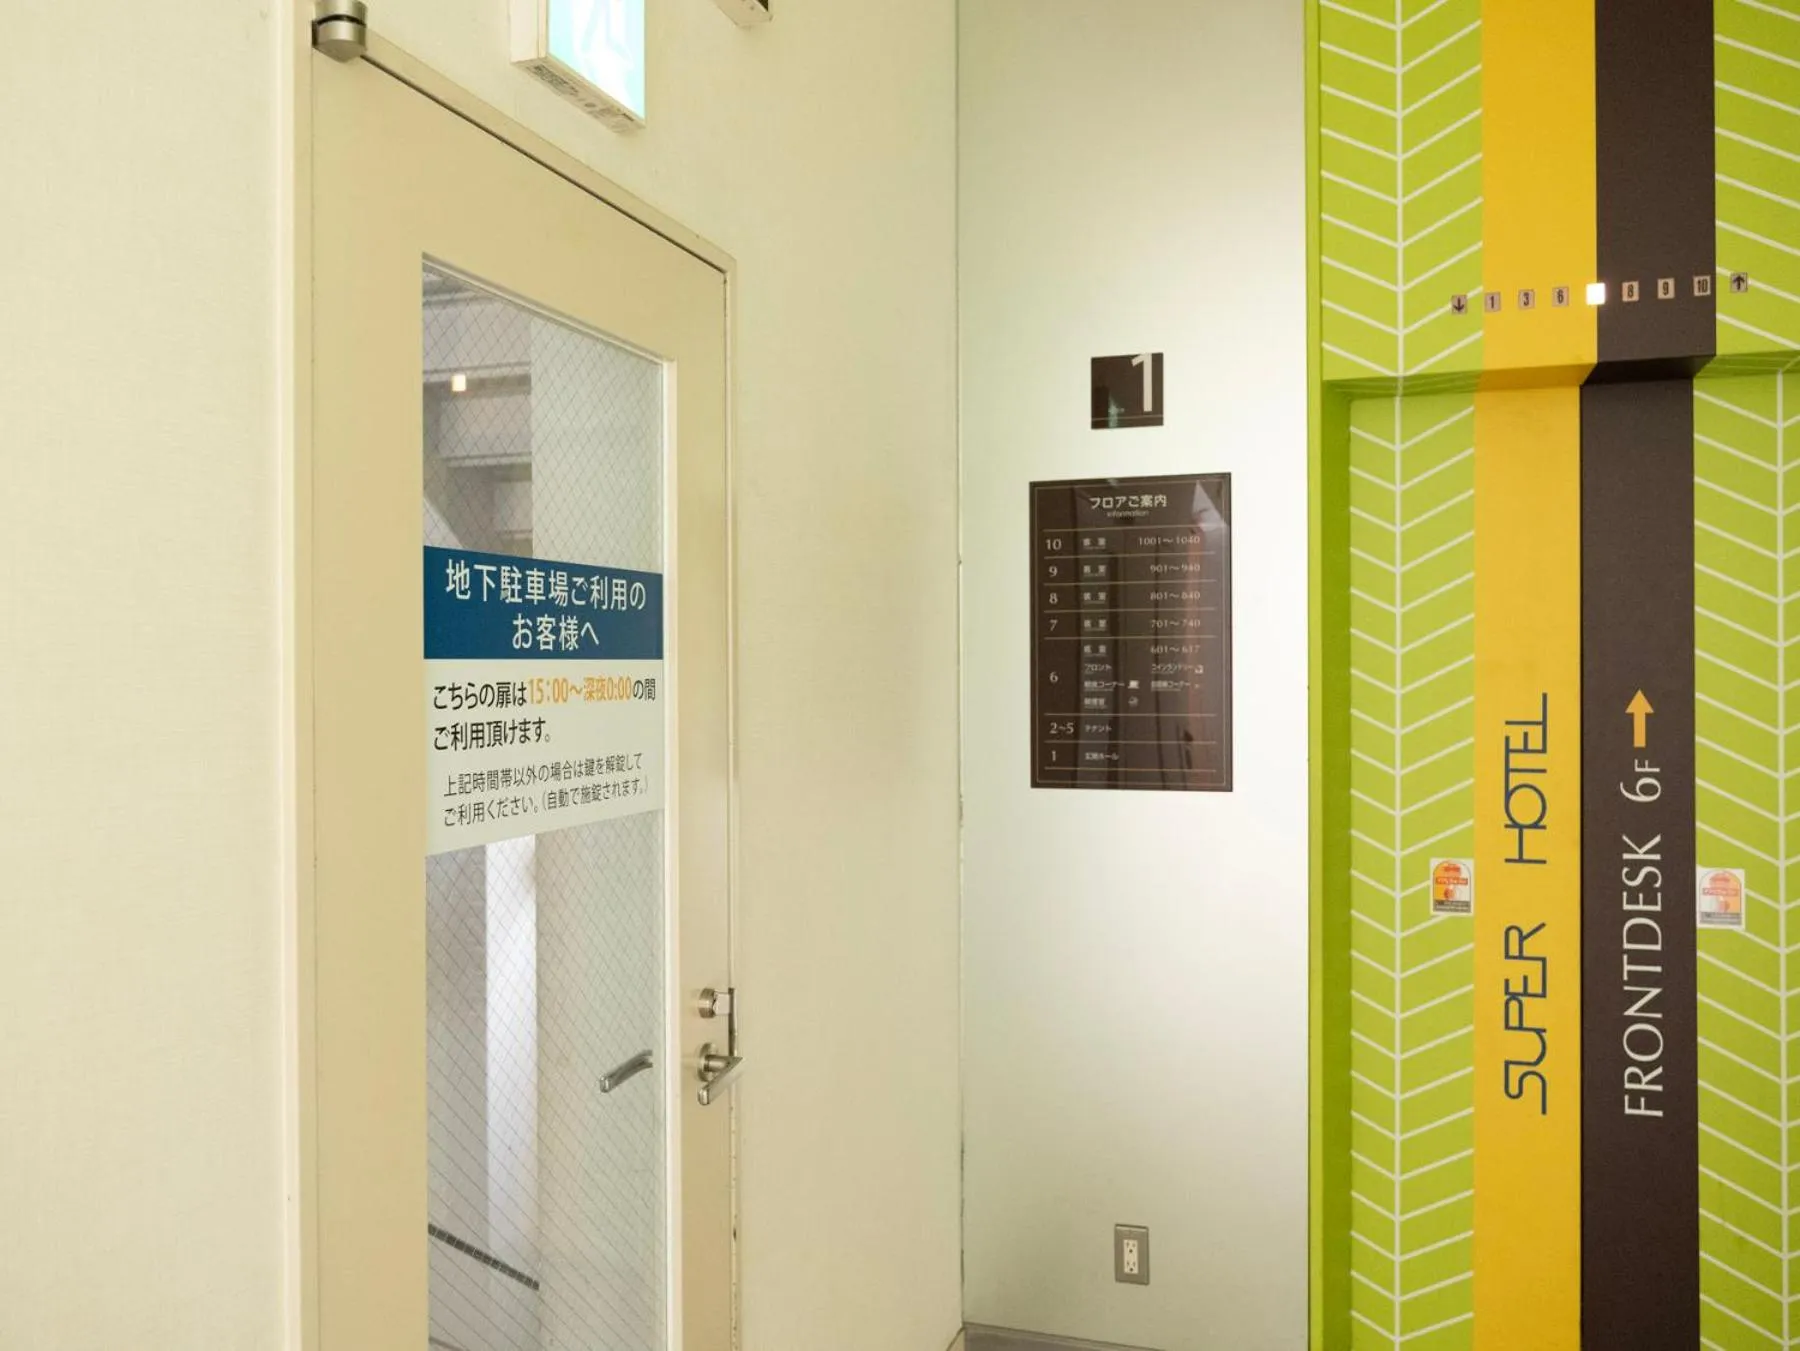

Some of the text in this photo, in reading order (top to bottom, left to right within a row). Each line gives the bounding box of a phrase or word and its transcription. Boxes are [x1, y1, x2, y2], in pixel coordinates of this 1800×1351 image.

[1697, 278, 1708, 293] 10
[1131, 352, 1152, 412] 1
[1089, 494, 1168, 510] フロアご案内
[1045, 538, 1062, 551] 10
[1048, 565, 1058, 577] 9
[446, 558, 647, 611] 地下駐車場ご利用の
[1048, 593, 1058, 605] 8
[511, 613, 600, 652] お客様へ
[1049, 619, 1058, 631] 7
[1049, 672, 1058, 683] 6
[433, 716, 552, 752] ご利用頂けます。
[1051, 751, 1057, 762] 1
[443, 752, 643, 798] 上記時間帯以外の場合は鍵を解錠して
[1503, 692, 1547, 1116] SUPER HOTEL
[1620, 757, 1664, 1118] FRONTDESK 6F
